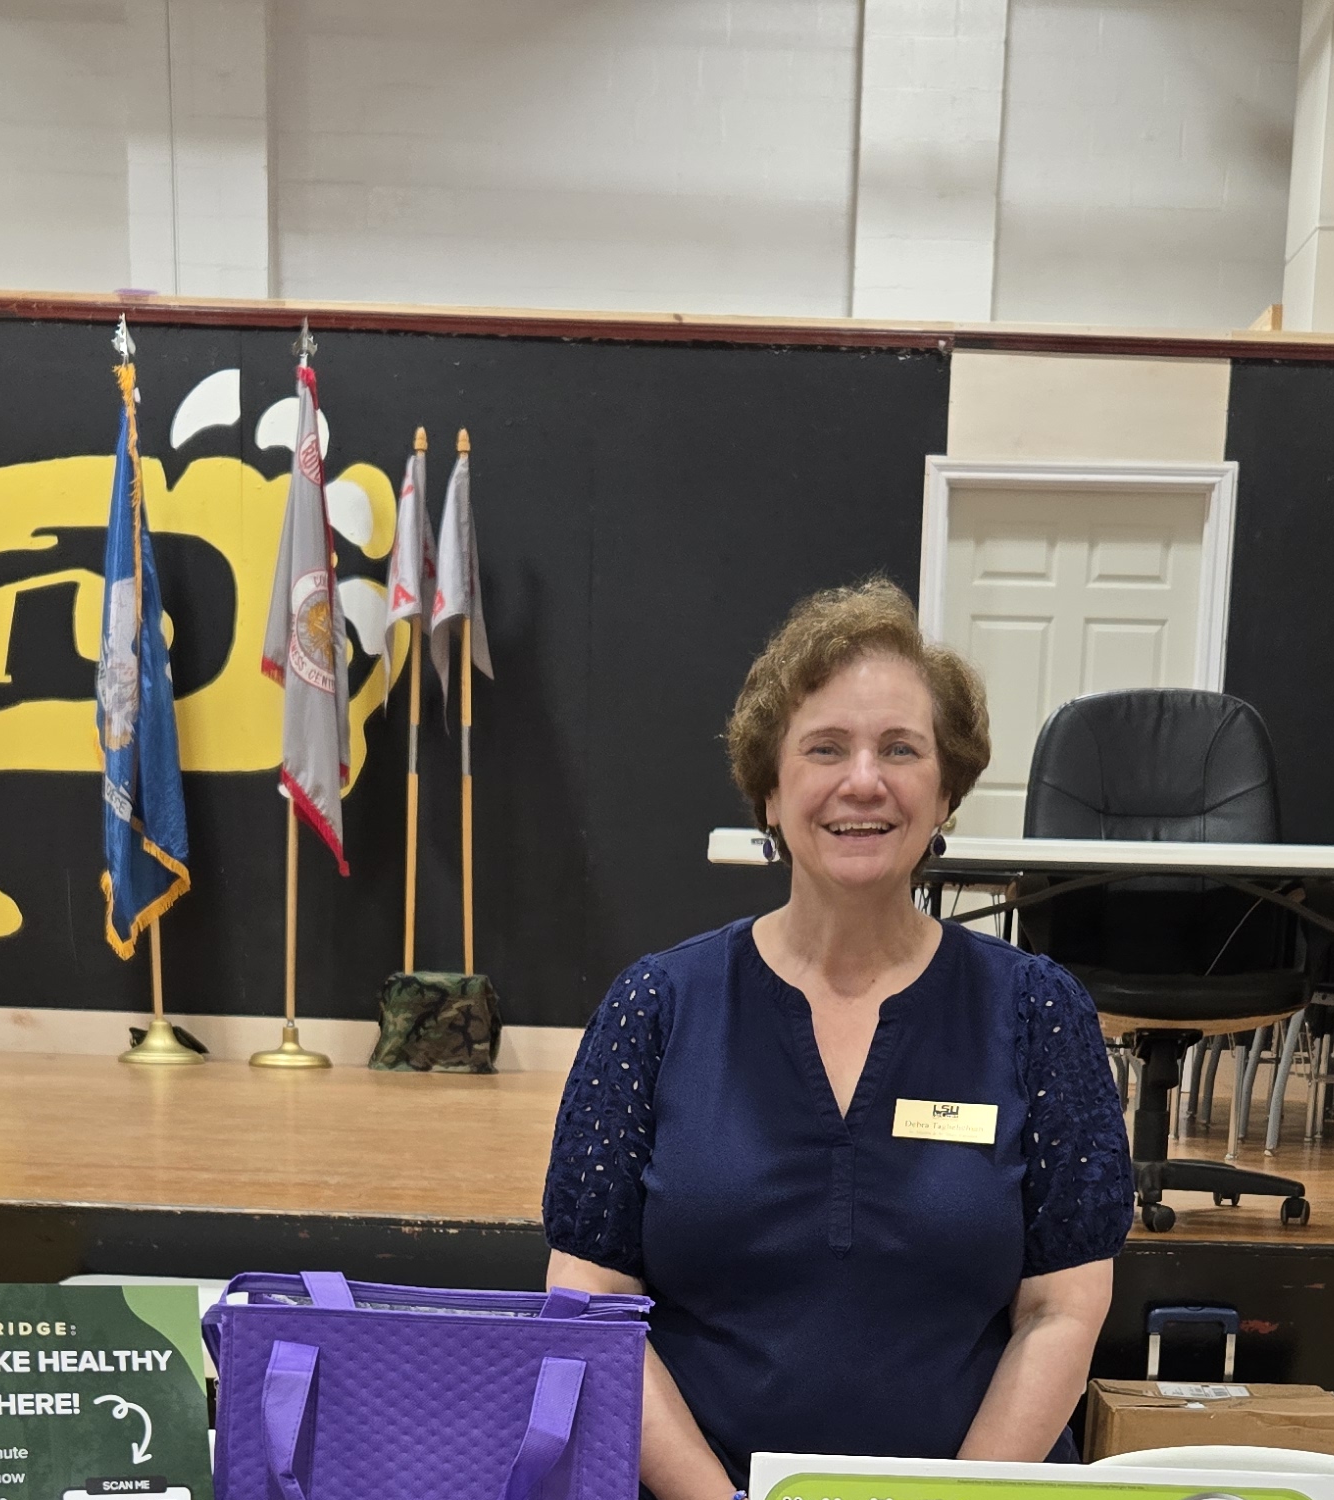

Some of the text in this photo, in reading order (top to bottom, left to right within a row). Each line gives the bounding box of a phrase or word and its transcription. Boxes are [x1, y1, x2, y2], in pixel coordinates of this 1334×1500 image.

[39, 1350, 172, 1372] HEALTHY
[103, 1480, 150, 1490] SCAN ME
